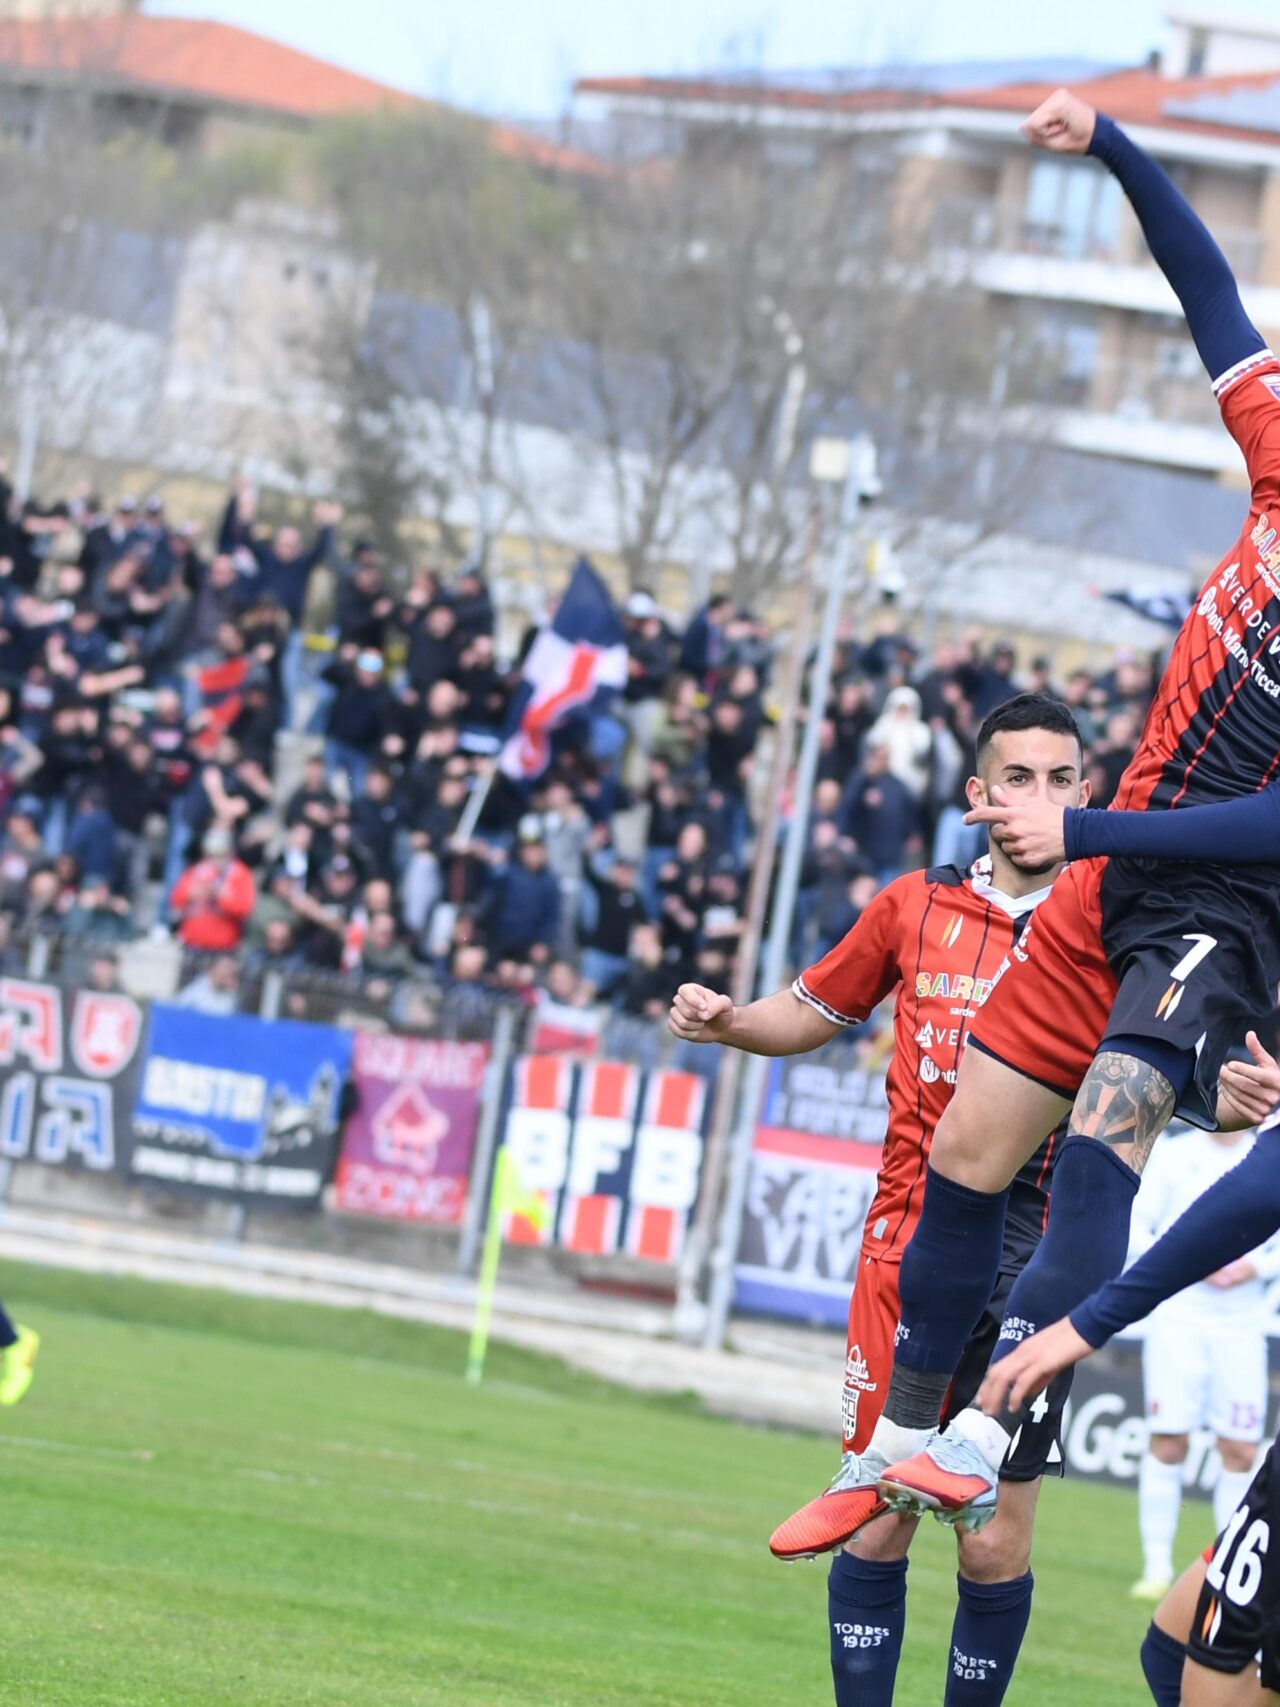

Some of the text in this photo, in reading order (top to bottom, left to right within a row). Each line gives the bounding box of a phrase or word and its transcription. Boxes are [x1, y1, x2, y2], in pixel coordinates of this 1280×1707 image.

[1226, 575, 1272, 640] VERDE
[1250, 659, 1280, 698] Ticca
[916, 972, 993, 1003] SARD
[505, 1105, 703, 1210] BFB
[1206, 1504, 1270, 1606] 16
[834, 1623, 890, 1637] TORRES
[842, 1635, 883, 1648] 1903
[953, 1646, 997, 1669] TORRES
[953, 1661, 986, 1680] 1903
